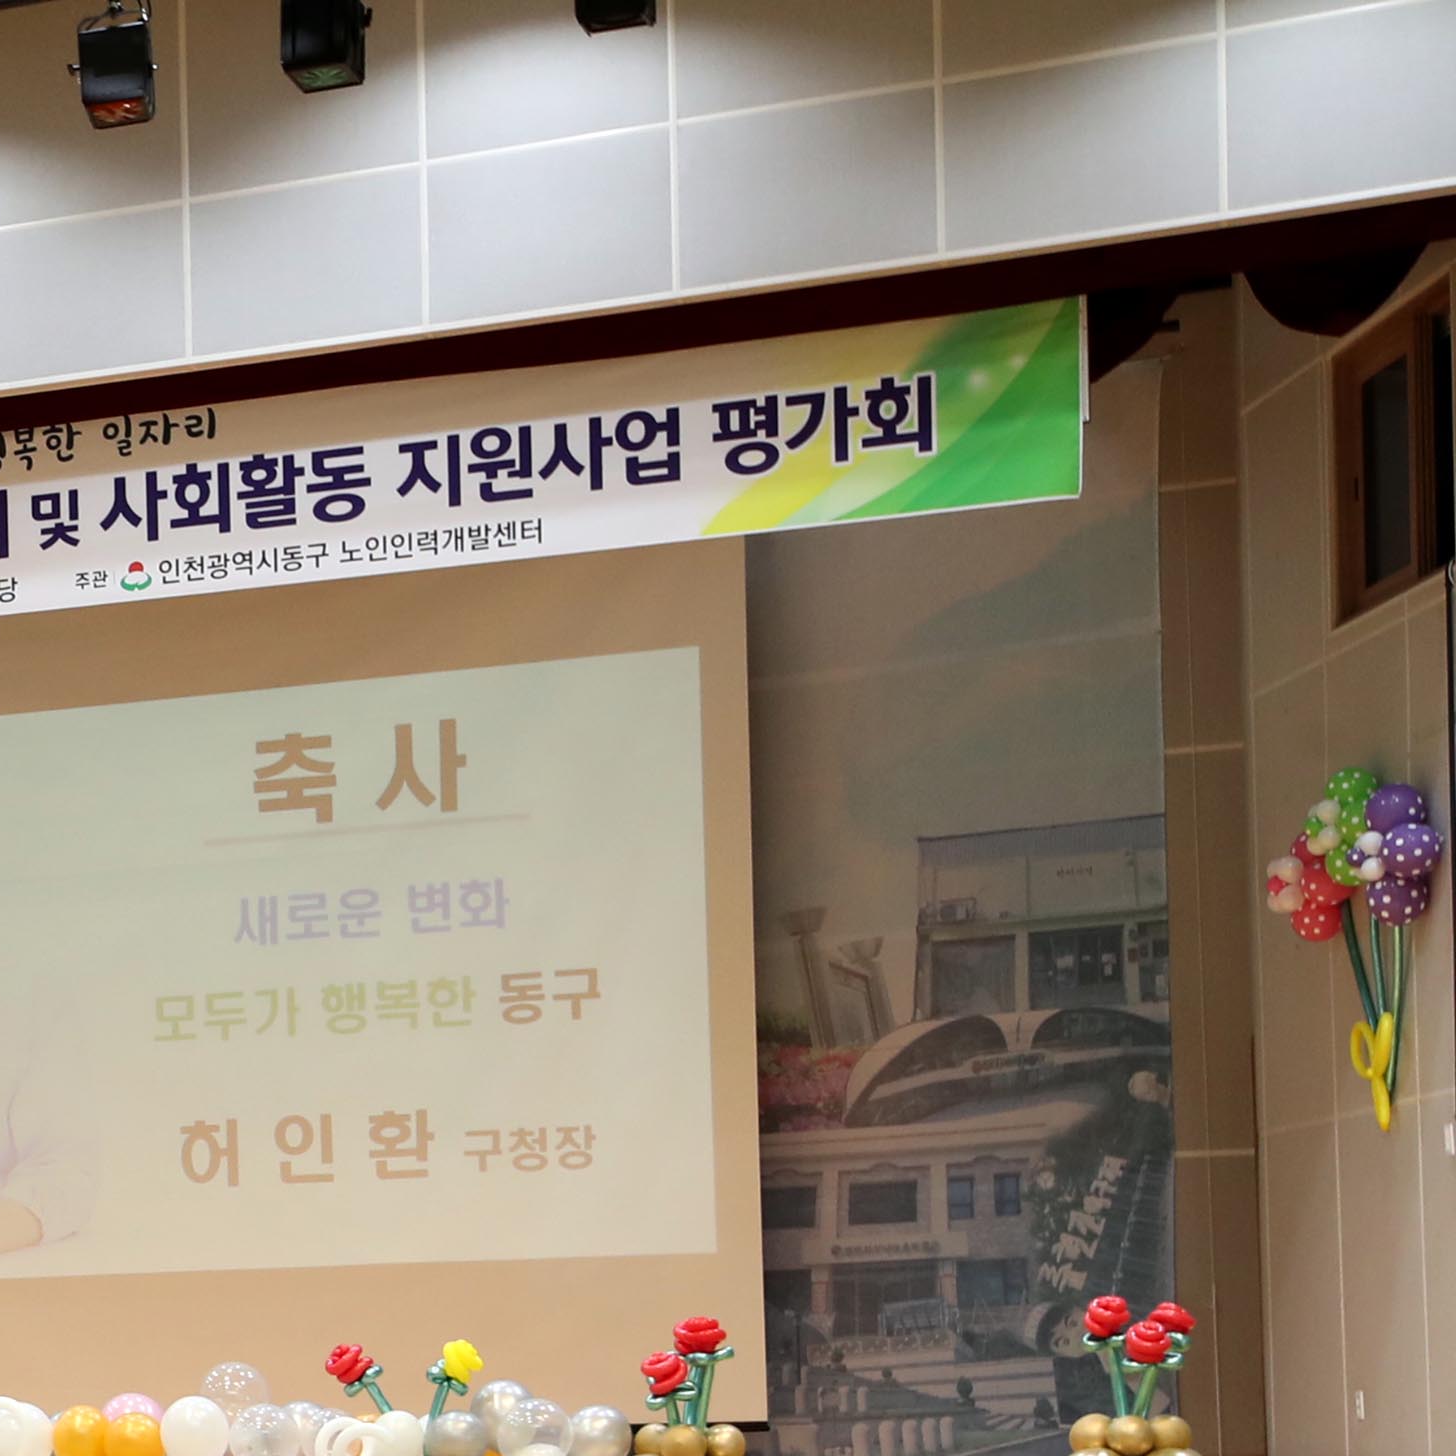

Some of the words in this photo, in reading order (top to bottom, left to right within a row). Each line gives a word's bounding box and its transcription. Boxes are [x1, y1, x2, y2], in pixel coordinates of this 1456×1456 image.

[30, 489, 81, 551] 및
[99, 445, 372, 542] 사회활동
[395, 407, 682, 508] 지원사업
[710, 374, 936, 475] 평가회
[102, 407, 217, 456] 일자리
[74, 570, 109, 590] 주관
[157, 541, 330, 586] 인천광역시동구
[338, 517, 544, 565] 노인인력개발센터
[233, 887, 383, 947] 새로운
[406, 876, 510, 935] 변화
[153, 986, 301, 1042] 모두가
[320, 974, 477, 1035] 행복한
[498, 967, 602, 1025] 동구
[463, 1123, 597, 1173] 구청장
